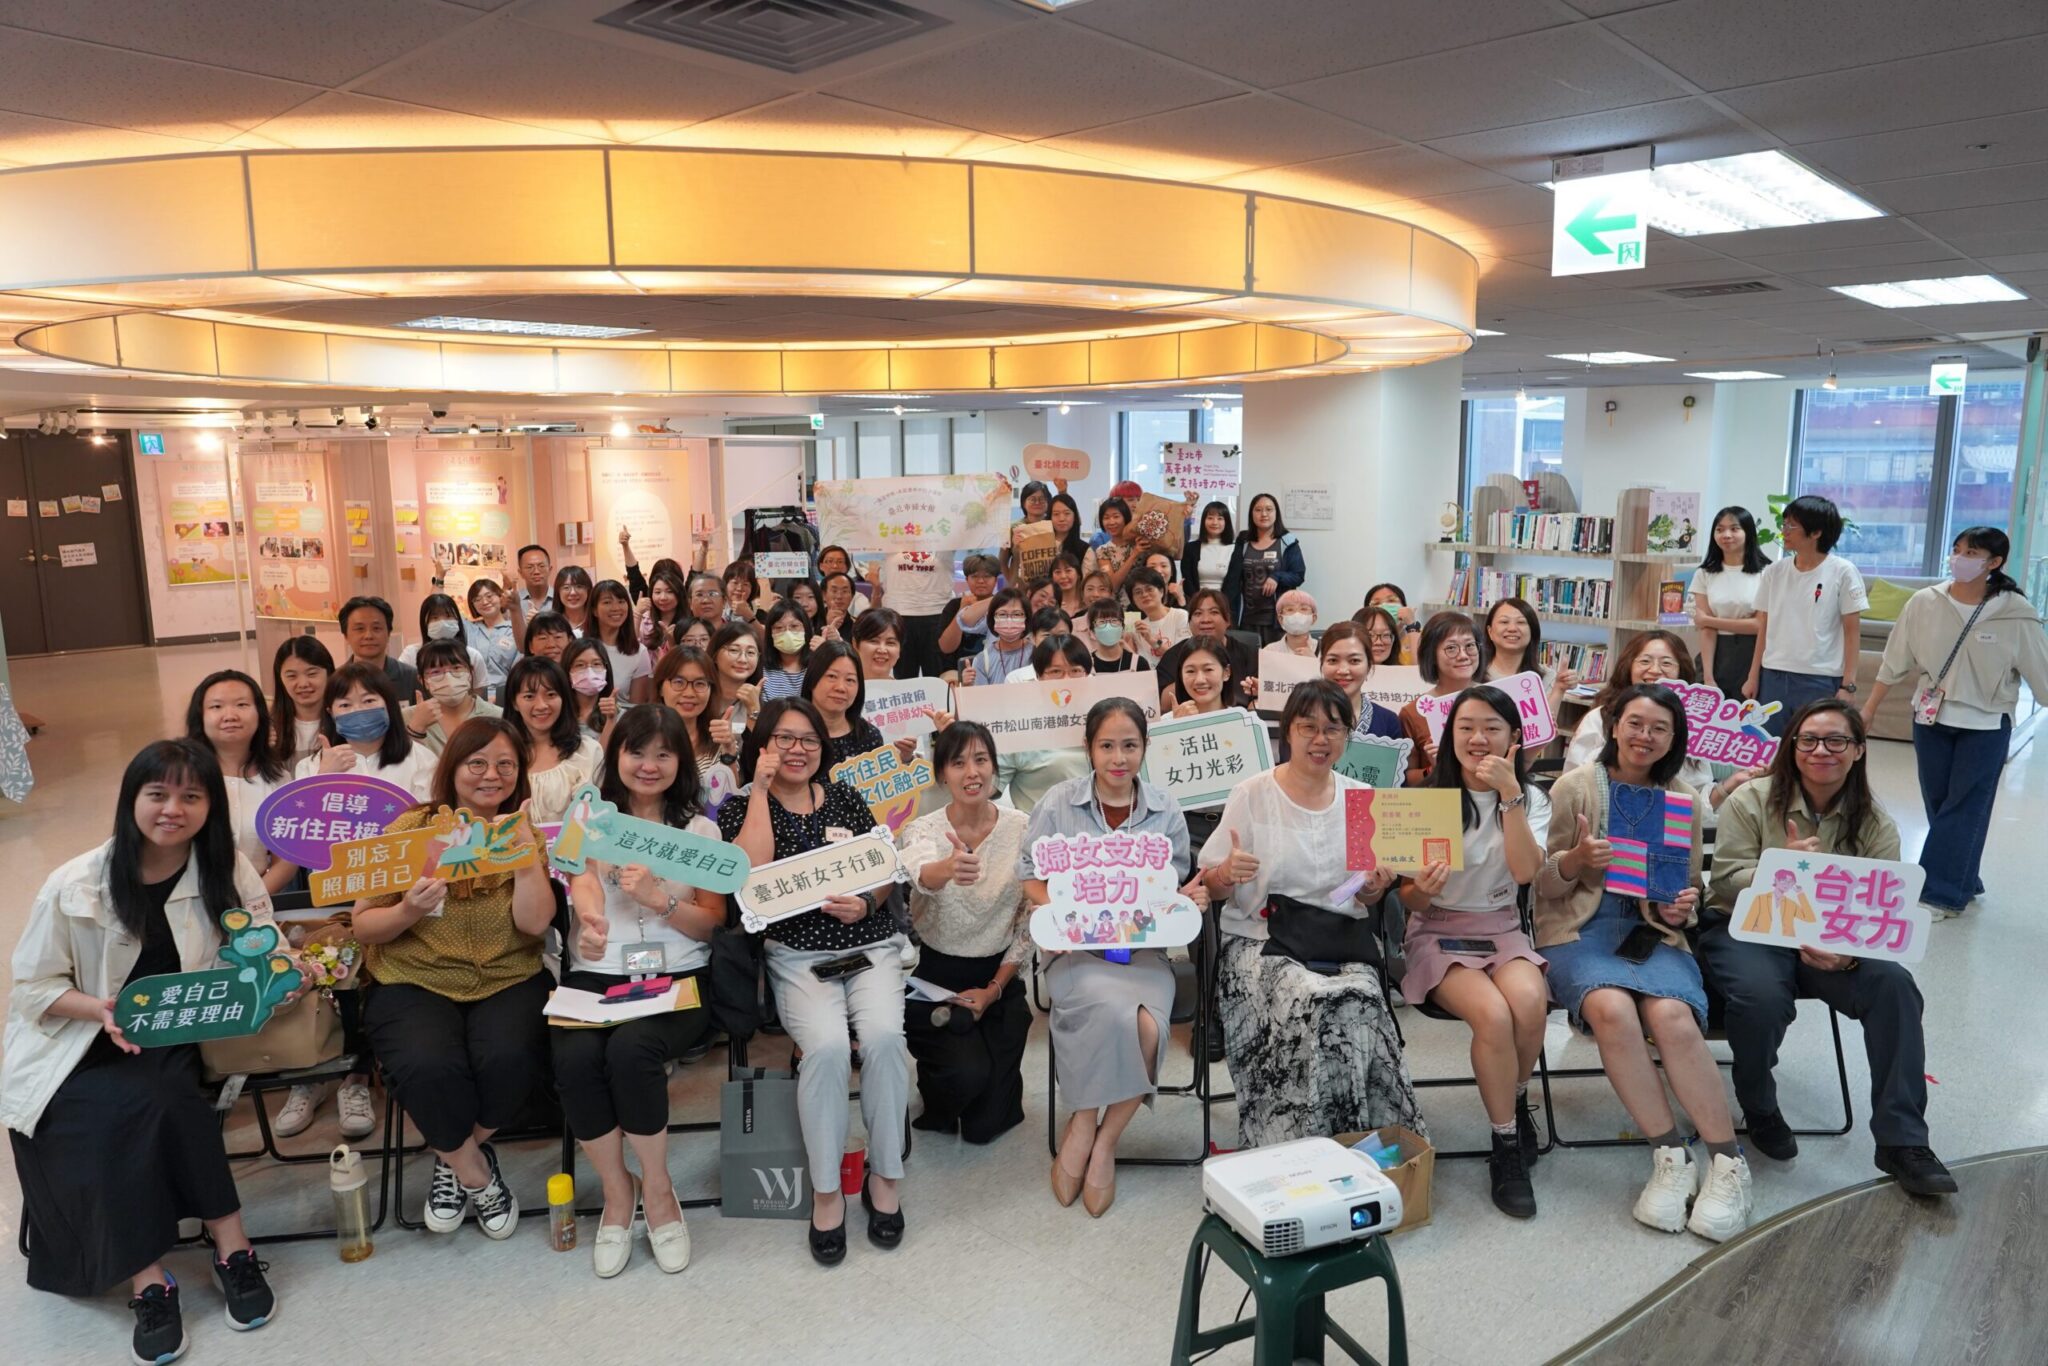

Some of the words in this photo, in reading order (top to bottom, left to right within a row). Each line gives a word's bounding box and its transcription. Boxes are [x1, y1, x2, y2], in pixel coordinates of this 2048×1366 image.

[1177, 448, 1203, 461] 臺北市
[1179, 478, 1237, 491] 支持培力中心
[864, 689, 926, 713] 臺北市政府
[1180, 732, 1219, 756] 活出
[836, 750, 898, 788] 新住民
[1165, 753, 1244, 787] 女力光彩
[321, 791, 370, 816] 倡導
[270, 815, 385, 842] 新住民權
[346, 839, 413, 869] 別忘了
[614, 829, 739, 877] 這次就愛自己
[1035, 833, 1170, 876] 婦女支持
[320, 864, 413, 899] 照顧自己
[752, 848, 886, 905] 臺北新女子行動
[1072, 870, 1139, 905] 培力
[1814, 864, 1903, 909] 台北
[1820, 905, 1910, 950] 女力
[158, 980, 230, 1007] 愛自己
[126, 1001, 245, 1033] 不需要理由
